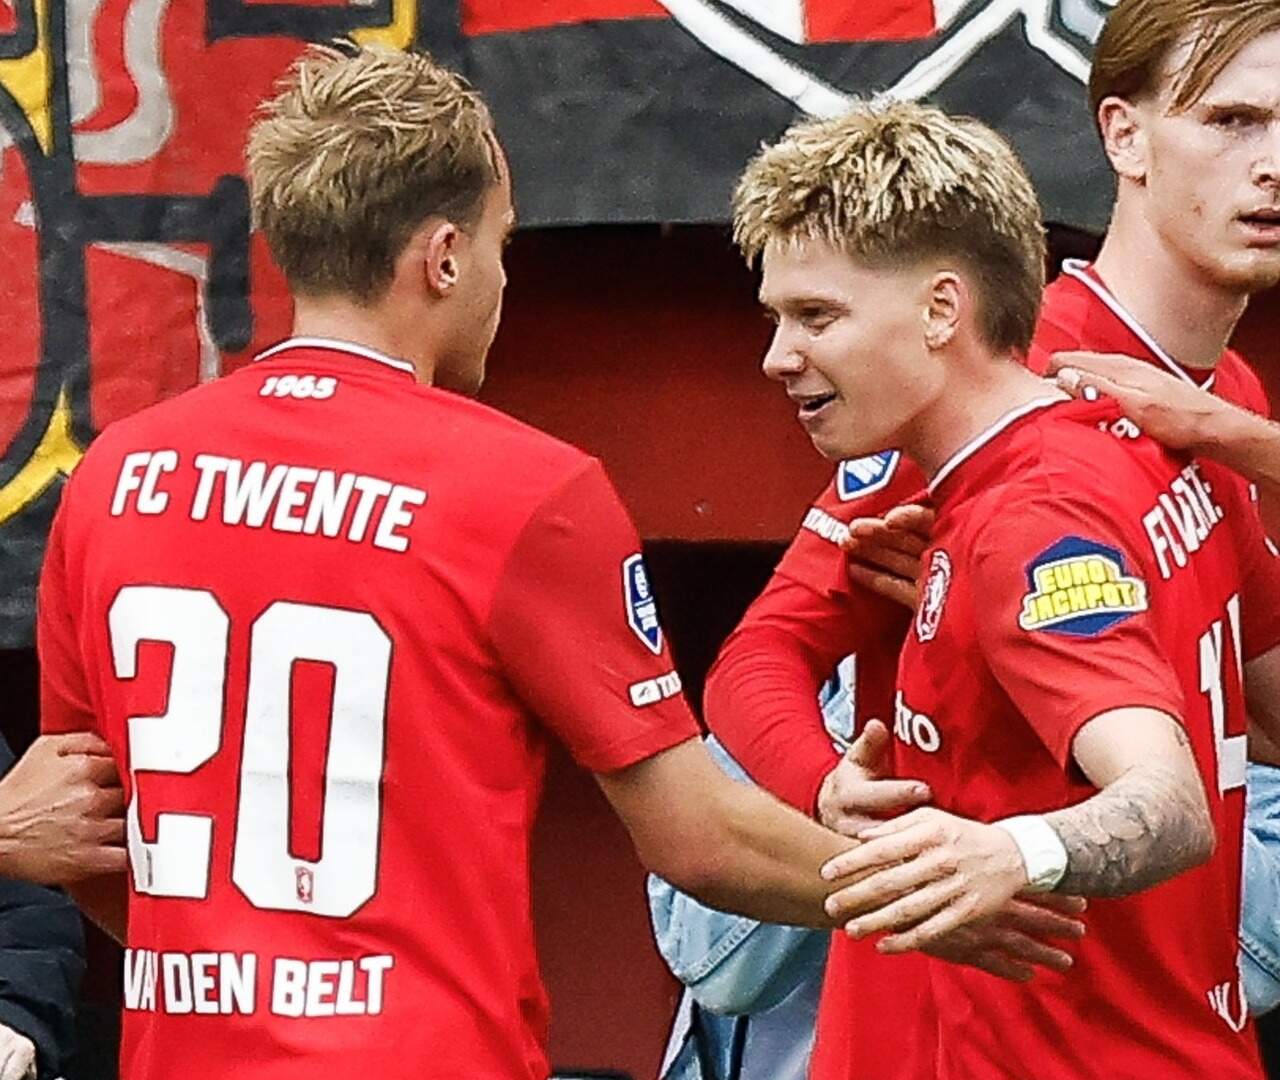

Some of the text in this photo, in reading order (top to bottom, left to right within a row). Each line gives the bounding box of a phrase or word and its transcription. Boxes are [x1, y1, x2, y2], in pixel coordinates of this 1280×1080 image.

[260, 374, 337, 399] 1965
[111, 451, 426, 552] FC TWENTE
[1022, 582, 1136, 626] JACKPOT
[1038, 558, 1108, 596] EURO
[107, 584, 394, 920] 20
[123, 949, 395, 1018] VA DEN BELT
